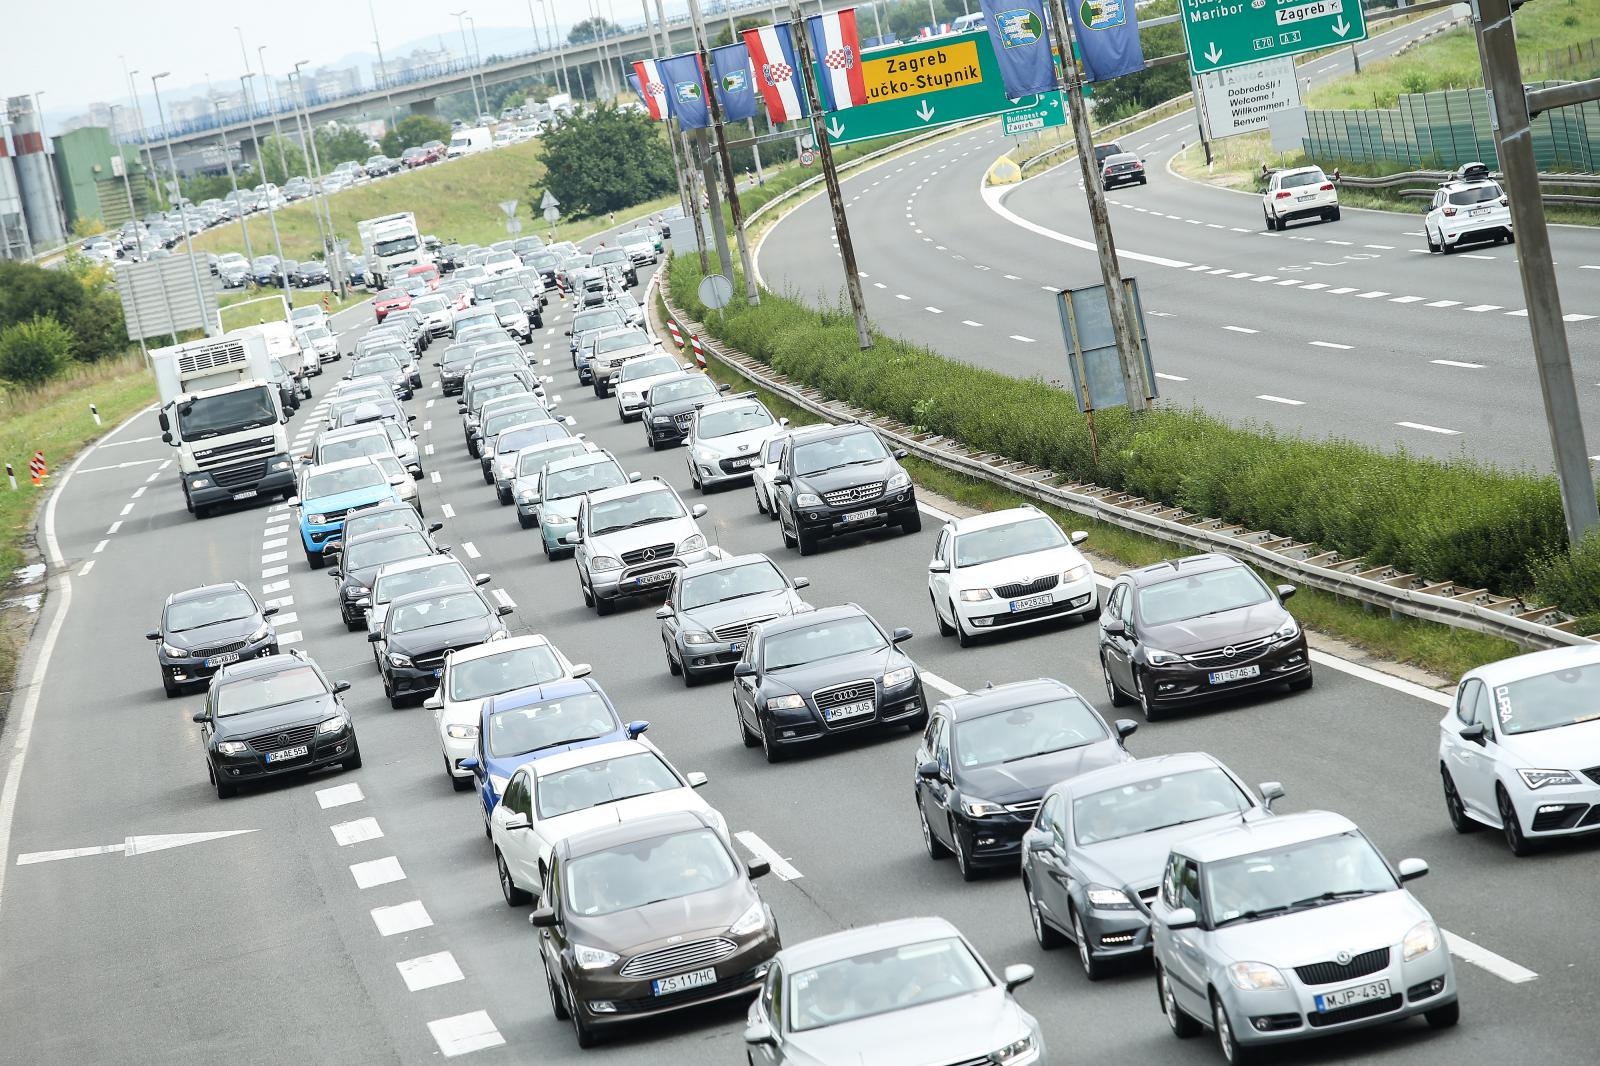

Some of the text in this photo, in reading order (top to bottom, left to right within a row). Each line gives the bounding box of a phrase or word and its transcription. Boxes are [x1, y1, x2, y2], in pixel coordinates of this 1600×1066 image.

[1190, 3, 1243, 23] Maribor
[1280, 4, 1325, 21] Zagreb
[886, 50, 948, 74] Zagreb
[866, 66, 979, 98] učko-Stupnik
[1228, 81, 1275, 97] Dobrodošli
[1229, 95, 1269, 107] Welcome
[1231, 101, 1285, 117] Willkommen
[831, 702, 870, 718] MS 12 JUS
[1496, 686, 1512, 724] CUPRA
[660, 969, 715, 992] ZS 117HC
[1326, 982, 1387, 1008] MJP-439
